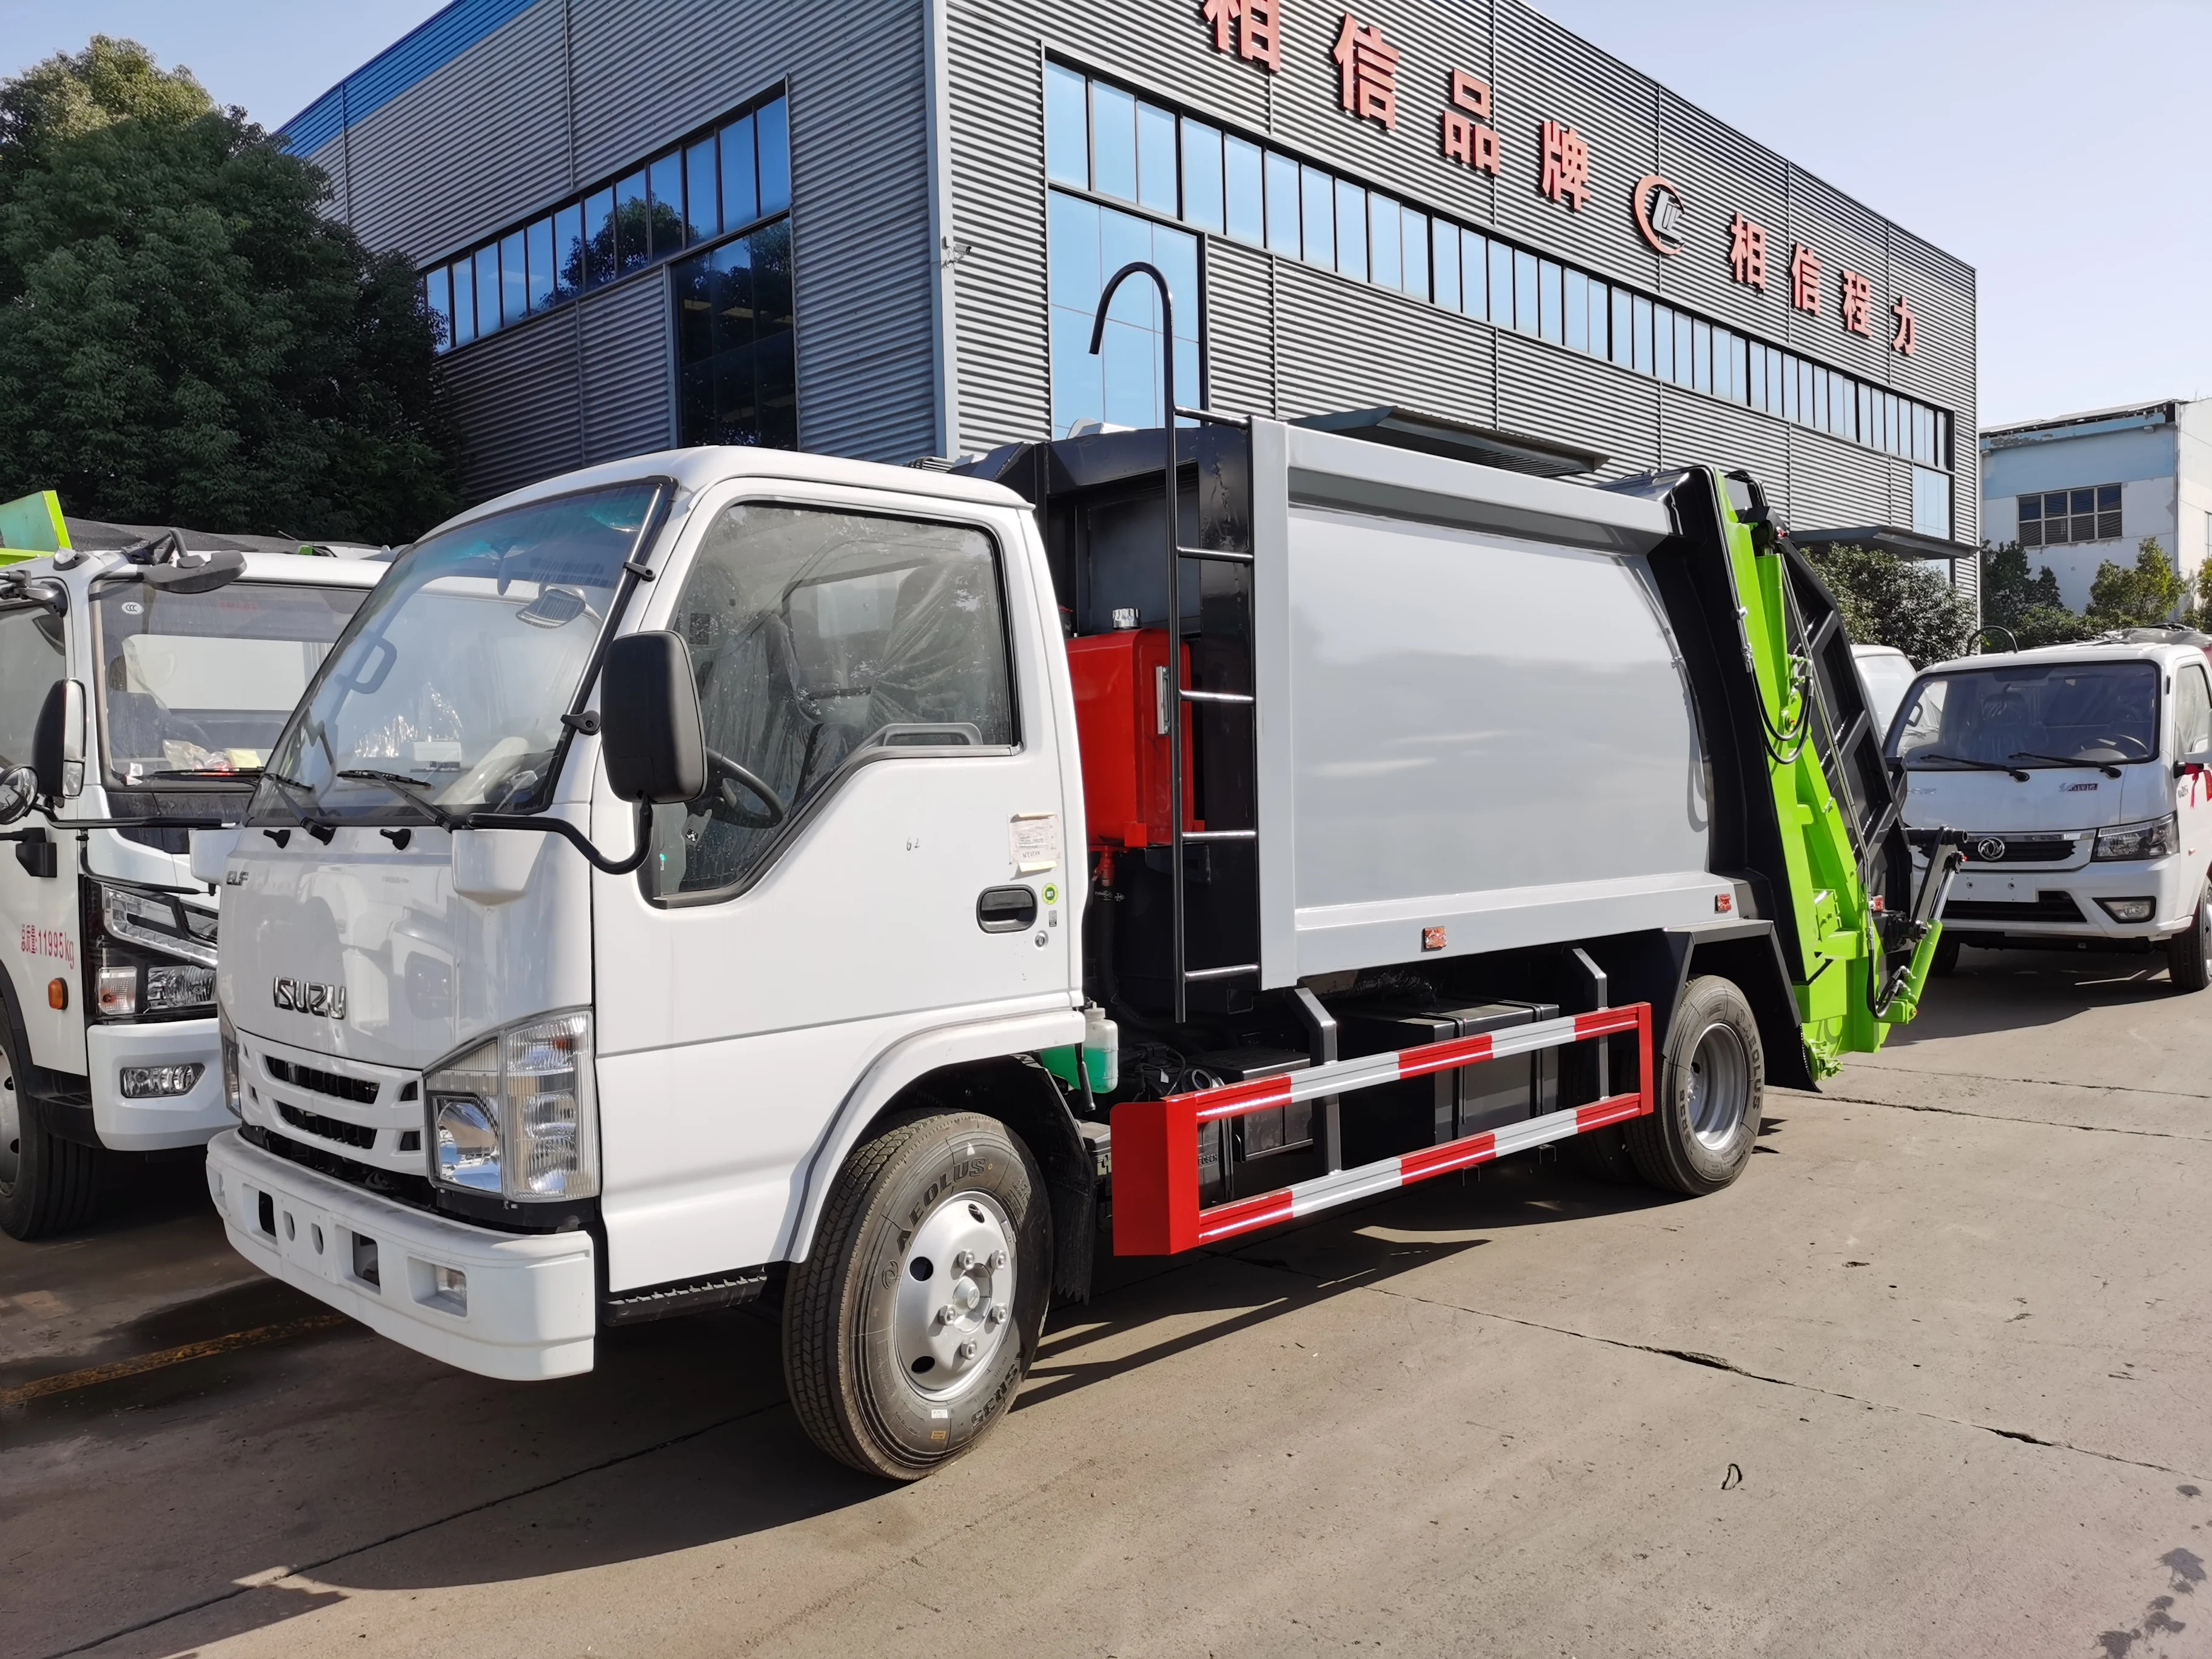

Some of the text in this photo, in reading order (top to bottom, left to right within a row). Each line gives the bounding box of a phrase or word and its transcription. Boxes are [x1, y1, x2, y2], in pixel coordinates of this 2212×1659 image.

[1730, 212, 1916, 355] 相信程力
[273, 975, 346, 1020] ISUZU
[1742, 1024, 1761, 1110] AEOLUS
[897, 1157, 986, 1257] AEOLUS
